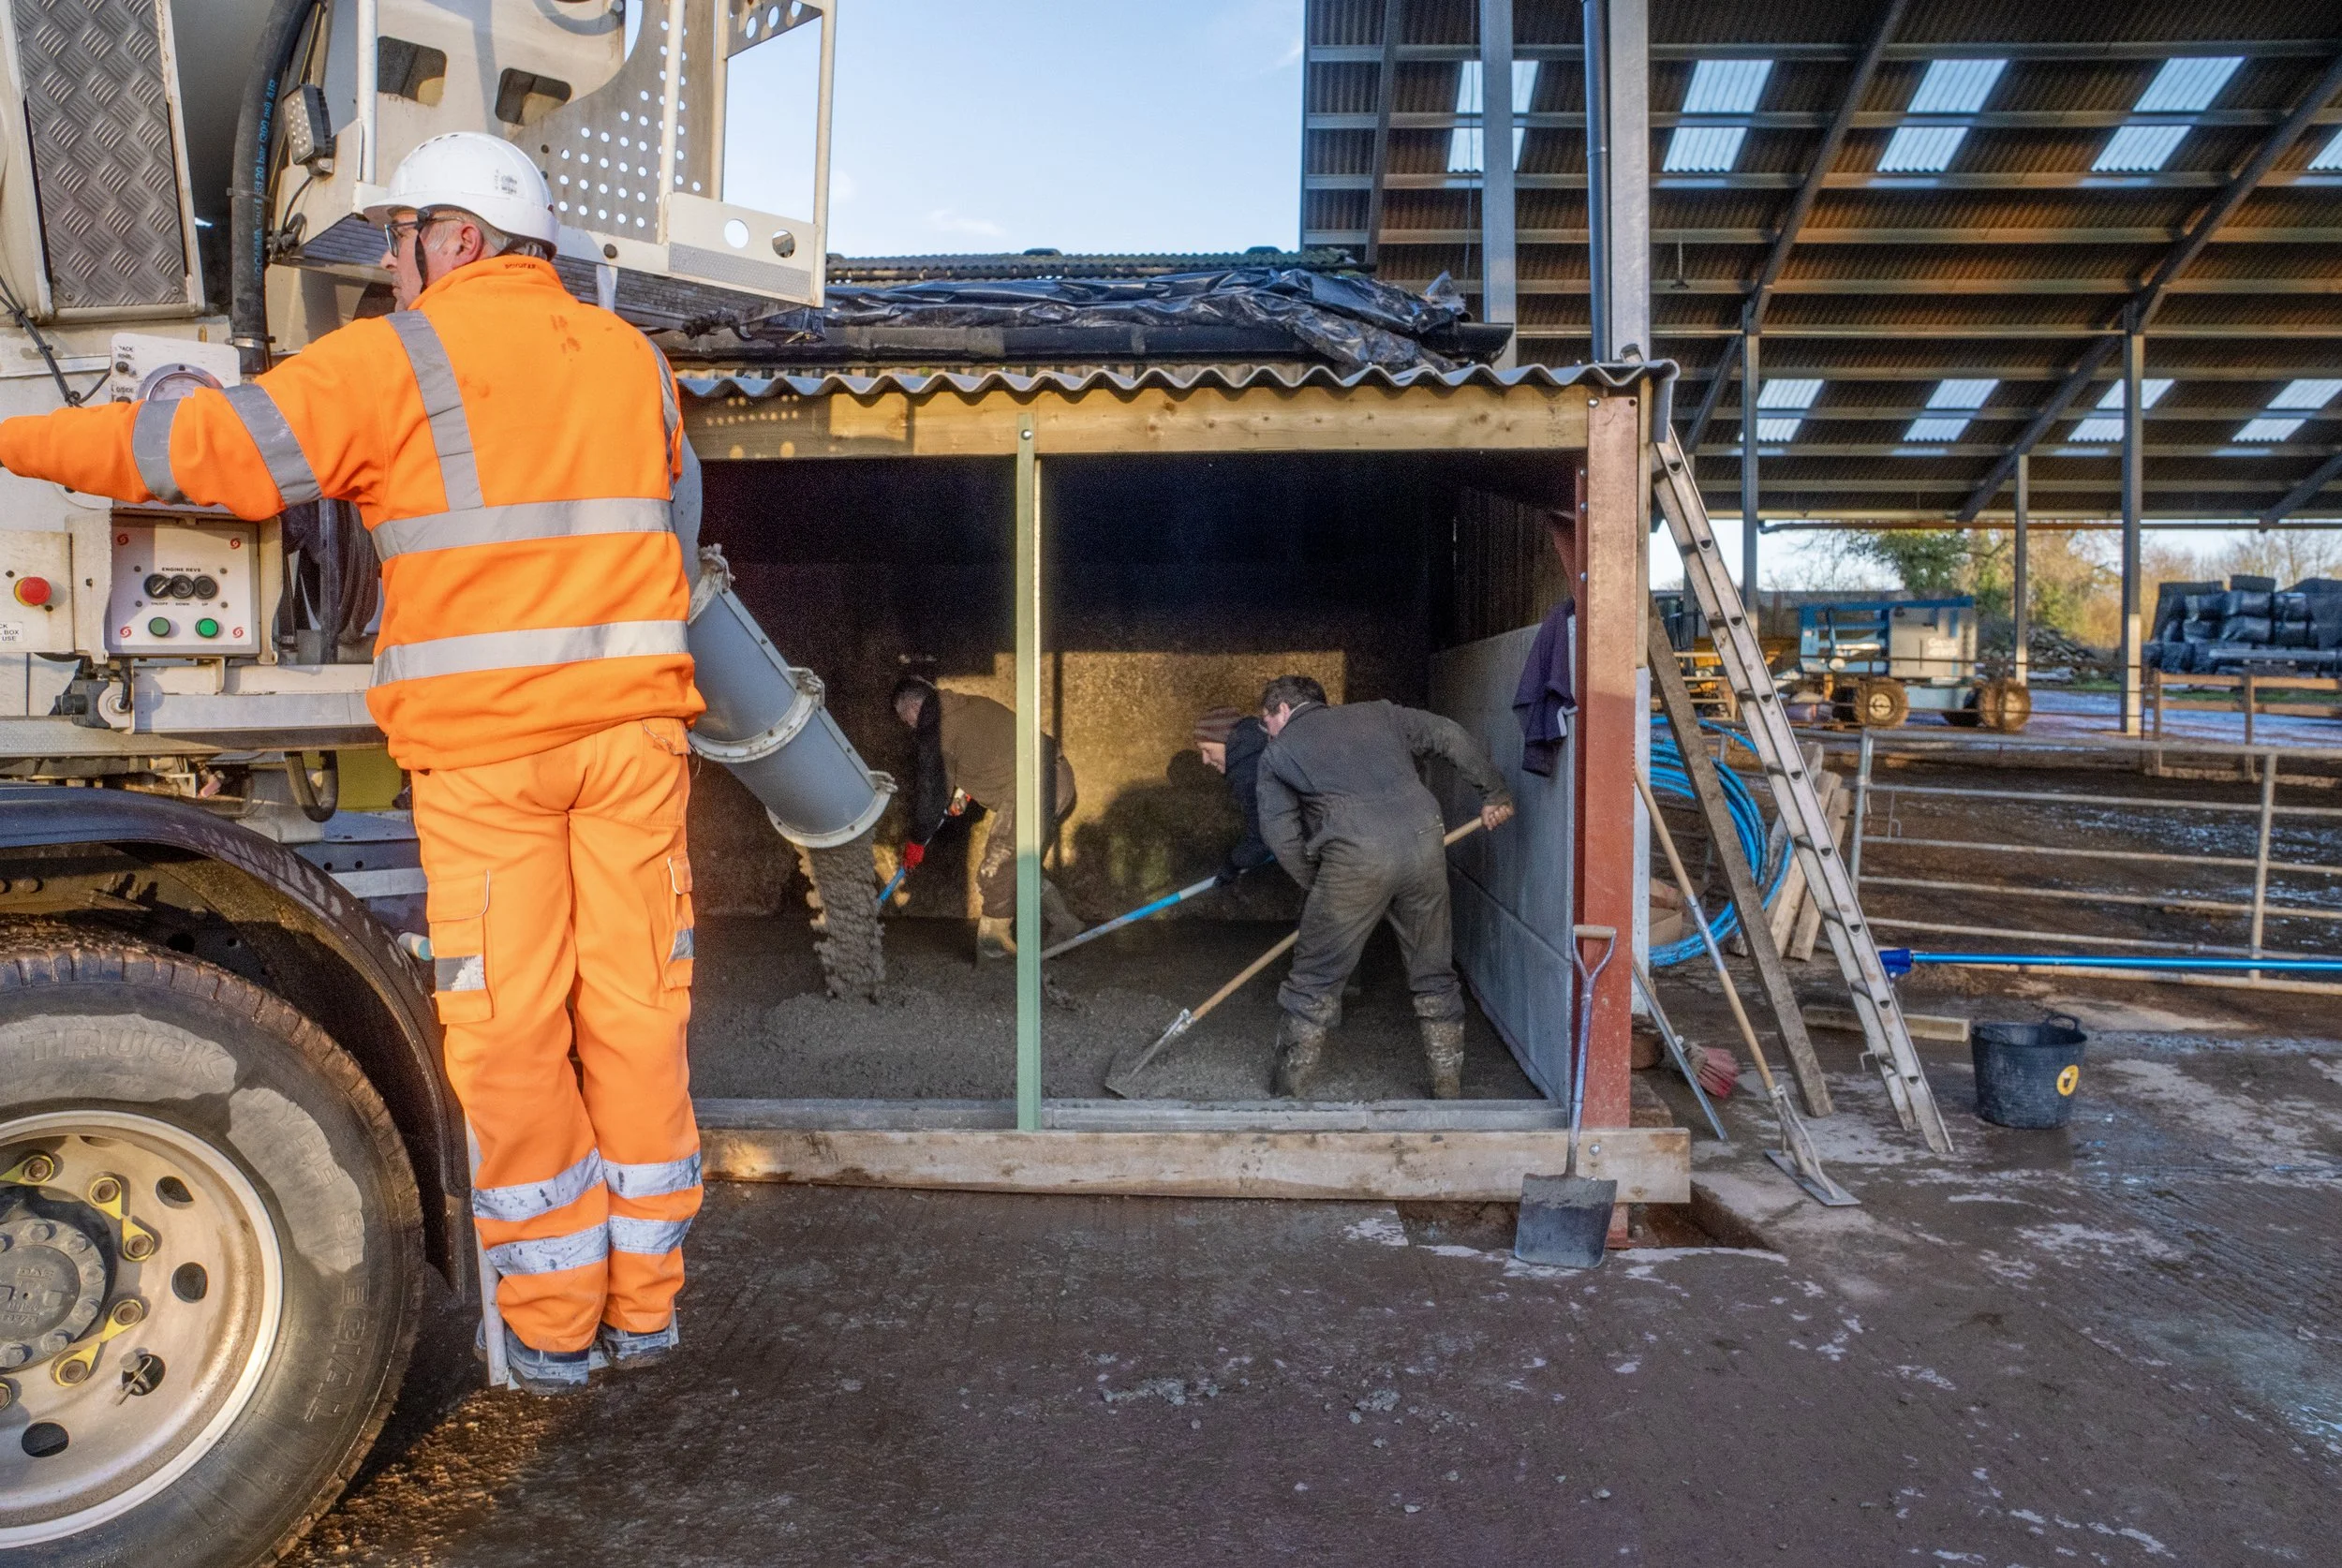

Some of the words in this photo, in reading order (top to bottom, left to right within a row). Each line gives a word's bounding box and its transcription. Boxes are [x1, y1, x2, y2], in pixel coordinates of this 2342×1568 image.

[256, 145, 267, 164] bar
[266, 79, 277, 98] AIR
[20, 1027, 230, 1080] TRUCK
[304, 1209, 370, 1422] SPECIAL
